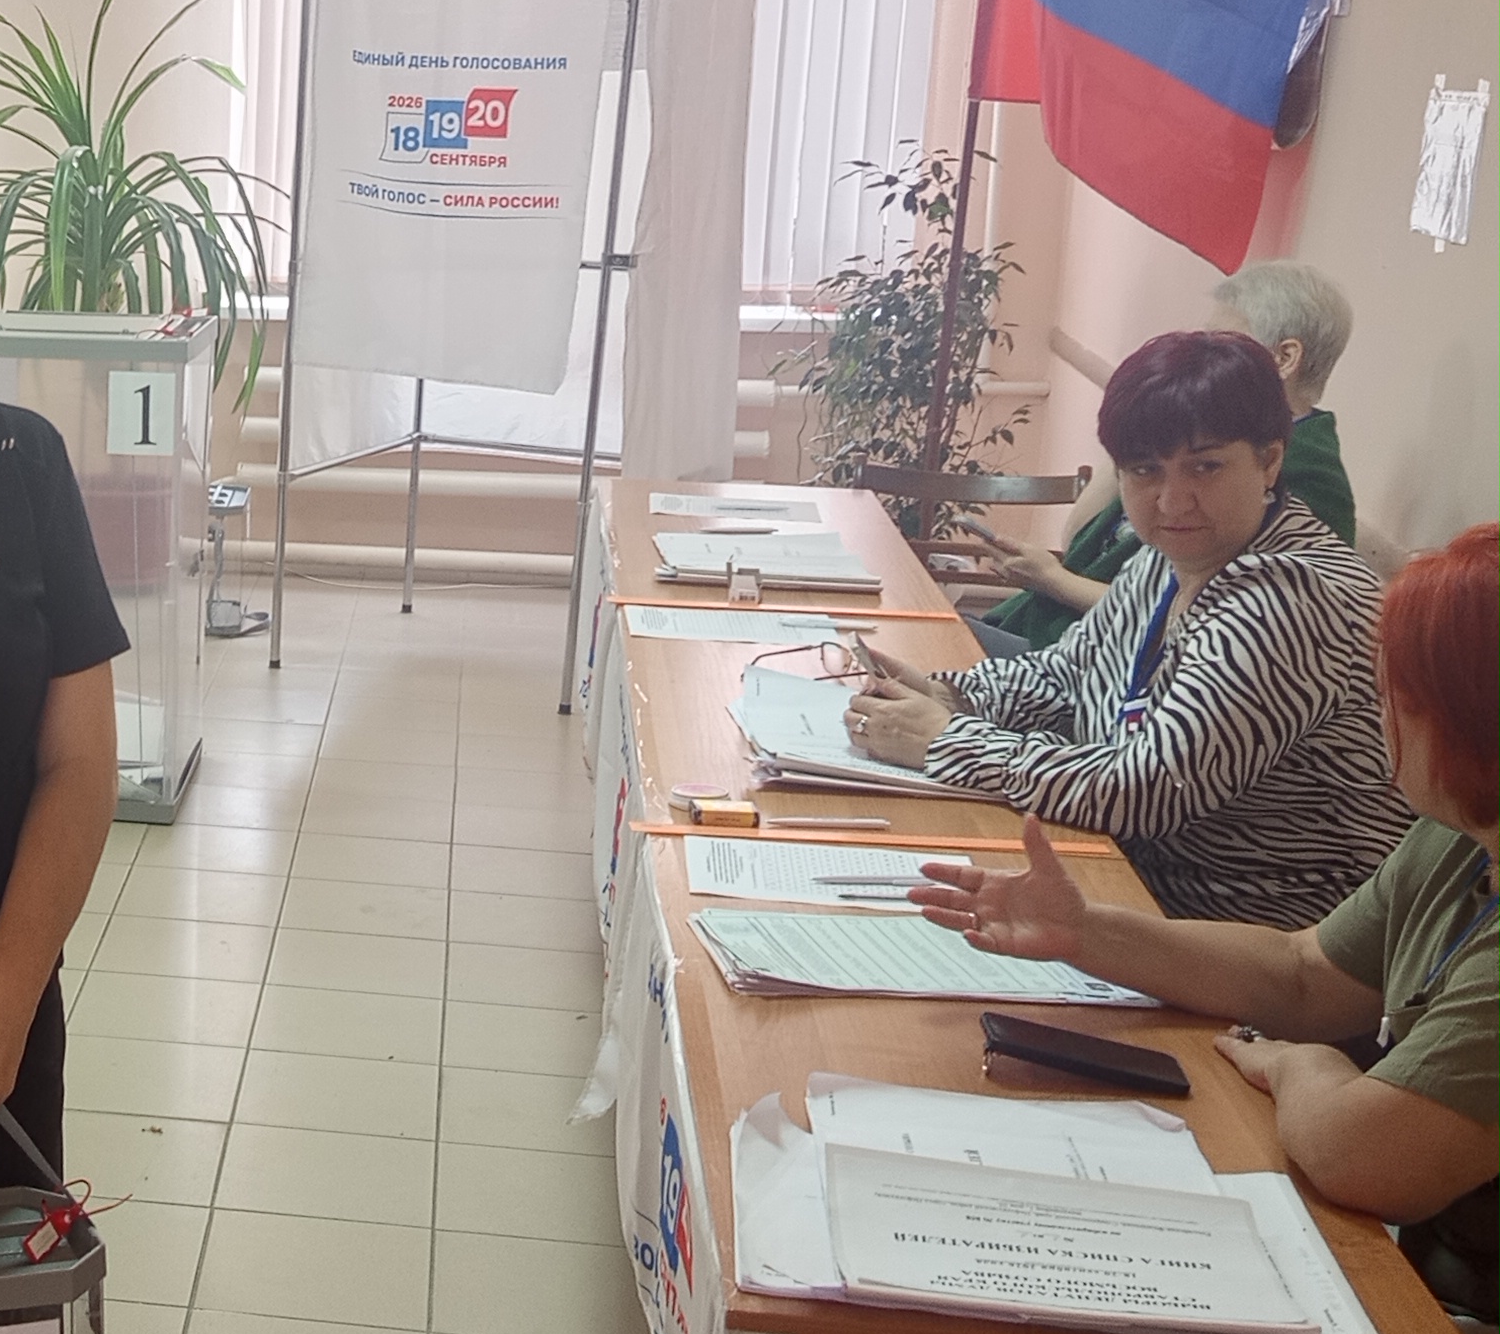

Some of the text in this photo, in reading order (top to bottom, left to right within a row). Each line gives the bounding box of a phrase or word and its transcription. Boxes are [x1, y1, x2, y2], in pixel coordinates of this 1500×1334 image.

[353, 50, 567, 70] ЕДИНЫЙ ДЕНЬ ГОЛОСОВАНИЯ
[388, 96, 423, 108] 2026
[390, 99, 506, 152] 18 19 20
[430, 153, 507, 167] СЕНТЯБРЯ
[349, 182, 379, 199] ТВОЙ
[381, 189, 426, 205] ГОЛОС
[443, 195, 485, 208] СИЛА
[489, 196, 559, 209] РОССИИ!
[133, 383, 158, 446] 1
[663, 1154, 681, 1233] 19
[1047, 1247, 1134, 1264] СПИСКА
[1141, 1257, 1211, 1270] КНИГА
